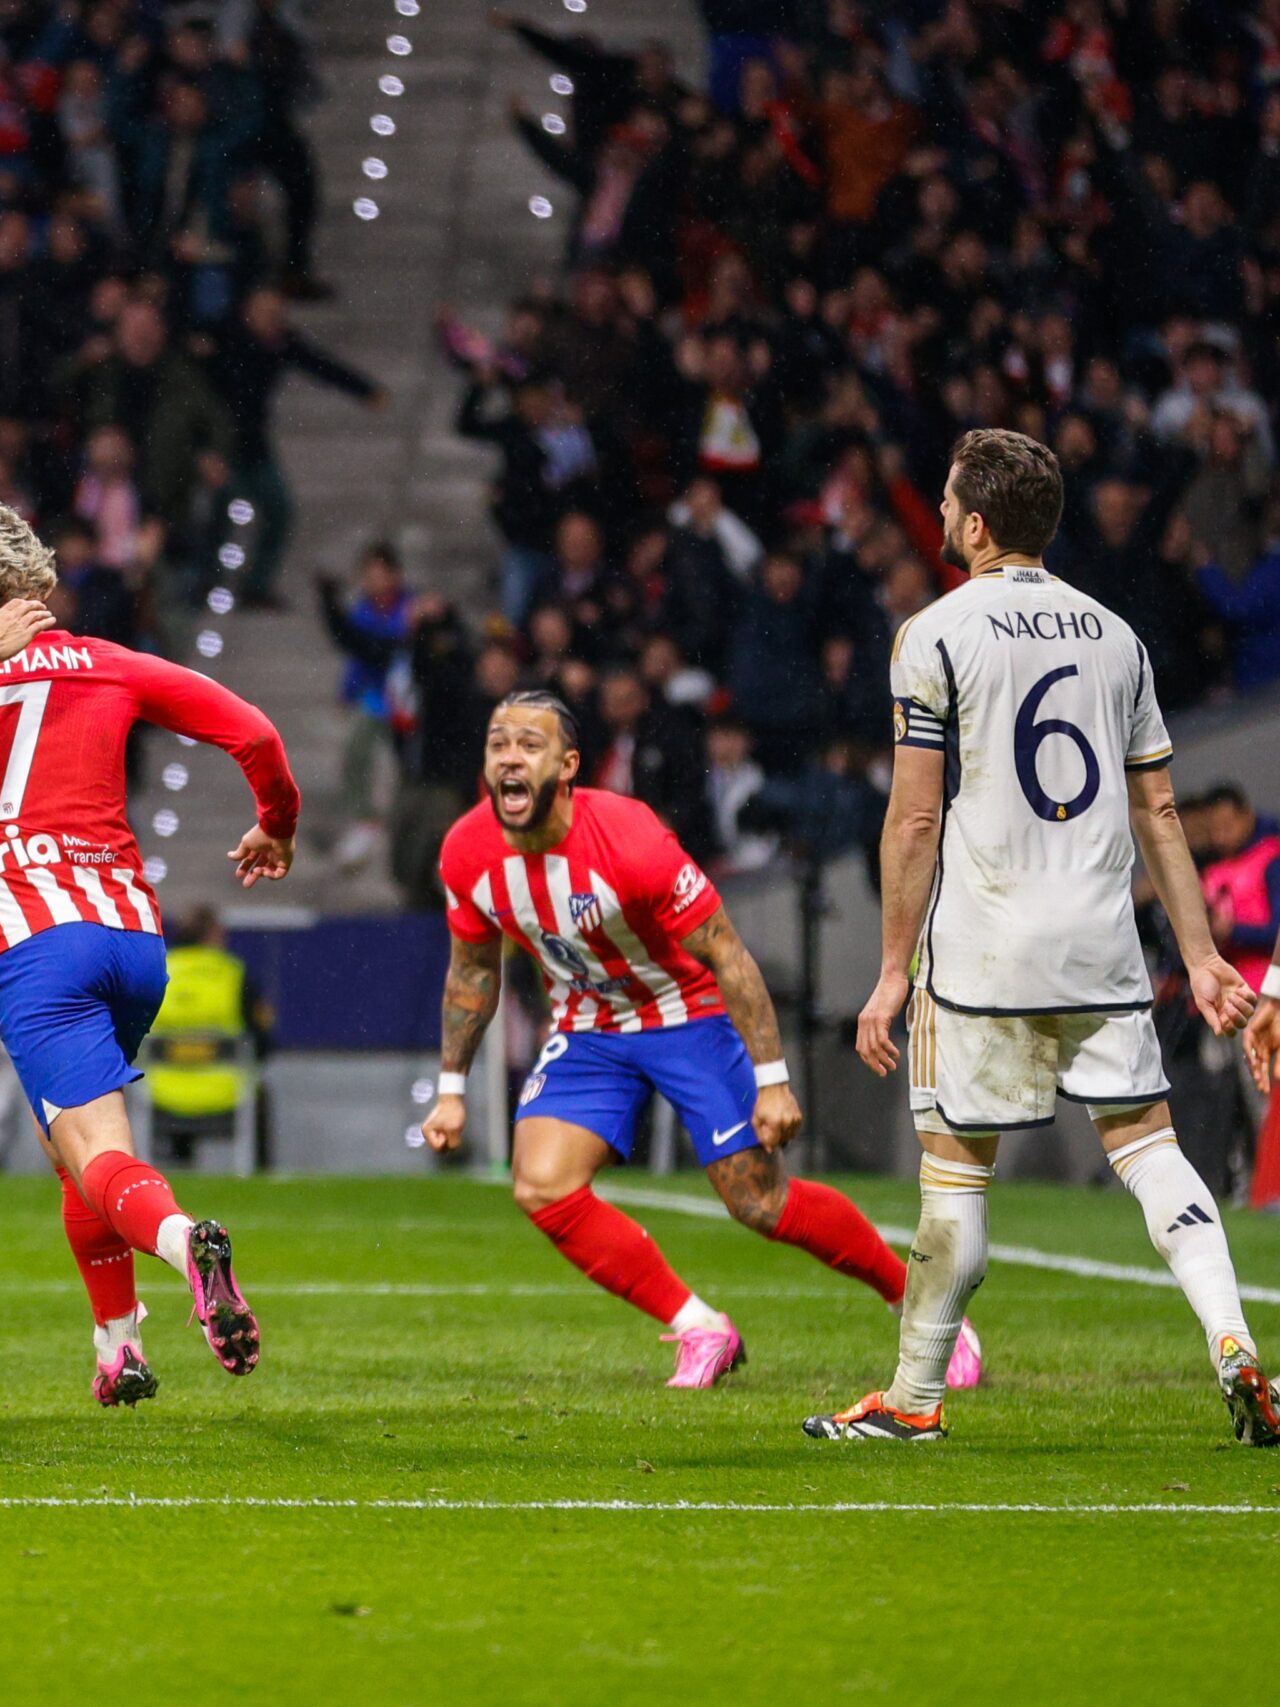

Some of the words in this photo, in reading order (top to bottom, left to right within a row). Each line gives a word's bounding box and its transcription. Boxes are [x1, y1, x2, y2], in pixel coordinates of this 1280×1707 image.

[986, 610, 1103, 641] NACHO
[1013, 663, 1100, 823] 6
[64, 849, 119, 864] Transfer
[117, 1179, 169, 1212] ATLETI
